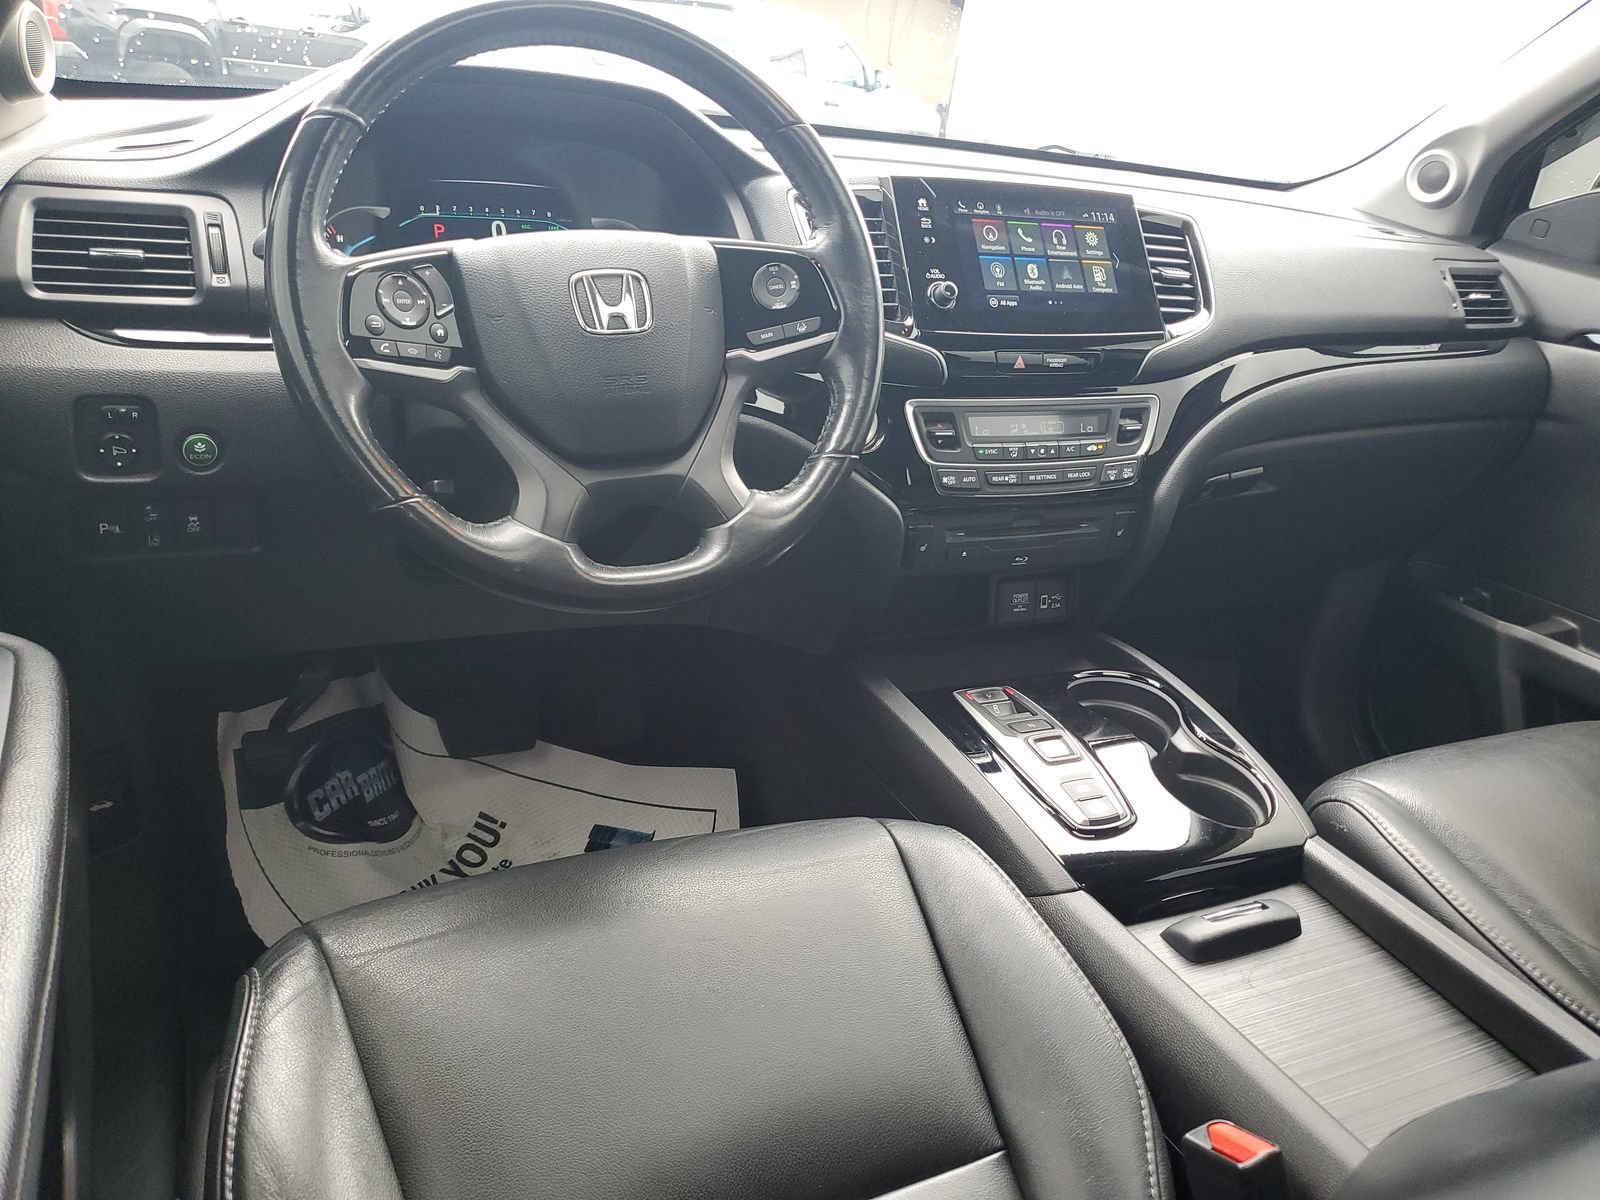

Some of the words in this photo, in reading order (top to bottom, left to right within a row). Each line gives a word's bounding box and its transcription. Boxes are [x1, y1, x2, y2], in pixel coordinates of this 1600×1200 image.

[1091, 212, 1115, 222] 11:14
[434, 223, 445, 239] P
[491, 220, 507, 237] 0
[307, 770, 360, 821] CAR
[439, 810, 508, 878] YOU!
